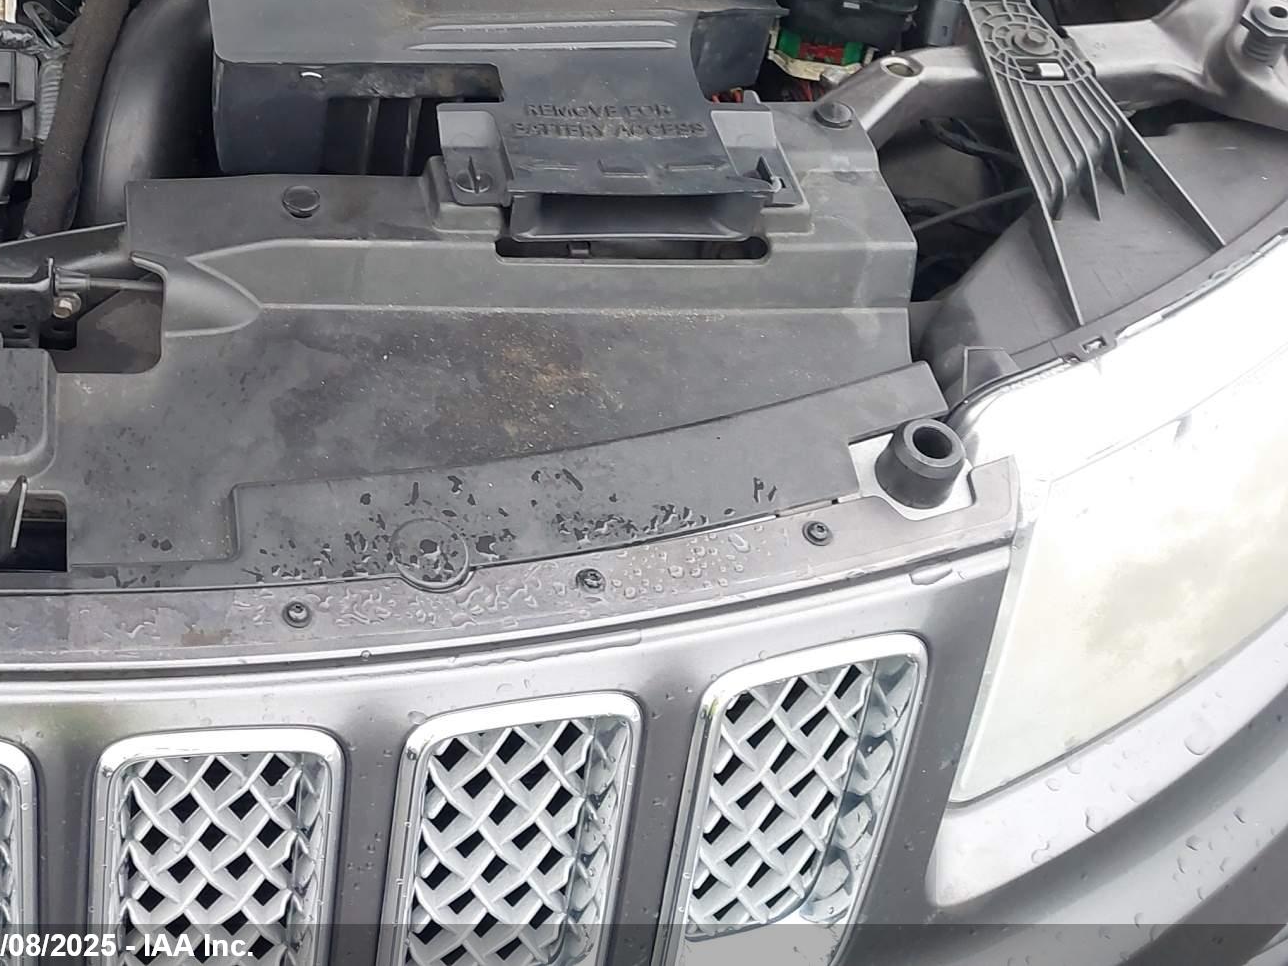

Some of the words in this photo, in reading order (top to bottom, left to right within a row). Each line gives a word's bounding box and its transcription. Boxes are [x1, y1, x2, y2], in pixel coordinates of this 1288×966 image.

[525, 104, 618, 119] REMOVE
[623, 103, 673, 119] FOR
[512, 121, 610, 139] BATTERY
[613, 121, 706, 138] ACCESS
